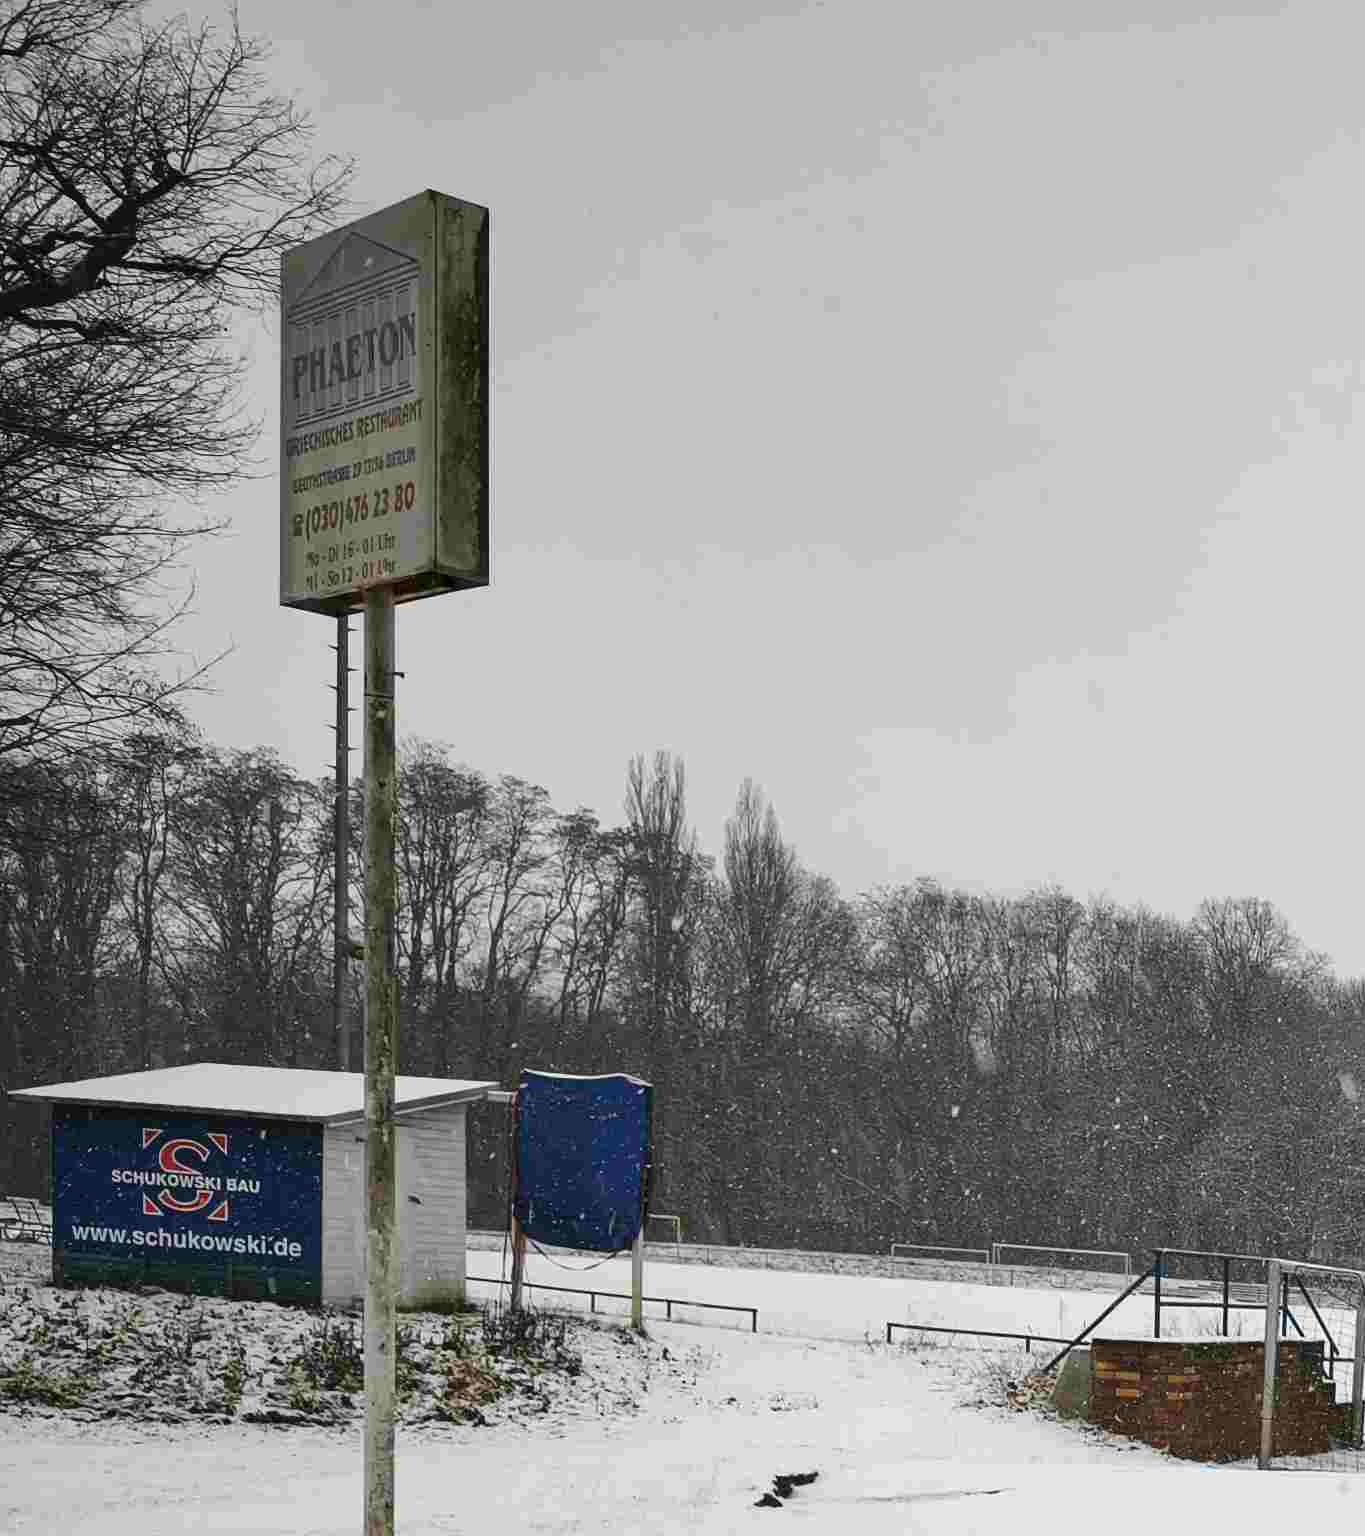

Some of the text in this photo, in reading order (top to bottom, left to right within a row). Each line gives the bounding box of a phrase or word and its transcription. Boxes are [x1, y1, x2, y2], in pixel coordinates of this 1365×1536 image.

[292, 313, 417, 399] PHAETON
[286, 399, 424, 457] GRIECHISCHES RESTAURANT
[373, 487, 389, 518] 23
[394, 482, 415, 512] 80
[111, 1169, 261, 1194] SCHUKOWSKI BAU
[72, 1224, 303, 1257] www.schukowski.de
